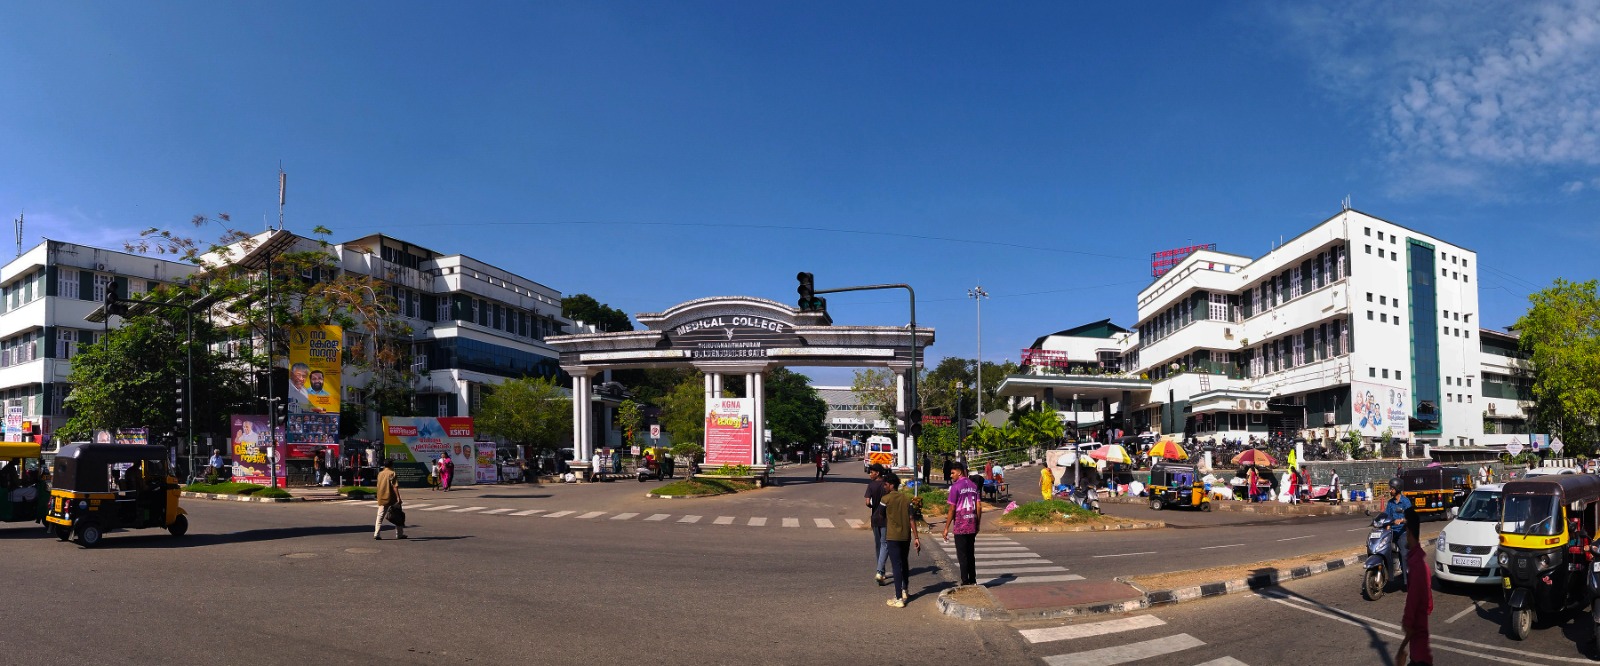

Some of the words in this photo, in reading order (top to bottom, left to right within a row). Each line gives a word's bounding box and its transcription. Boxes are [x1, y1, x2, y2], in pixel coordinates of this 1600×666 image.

[676, 317, 725, 336] MEDICAL
[732, 316, 784, 333] COLLEGE
[748, 349, 766, 357] GATE
[722, 400, 741, 408] KGNA
